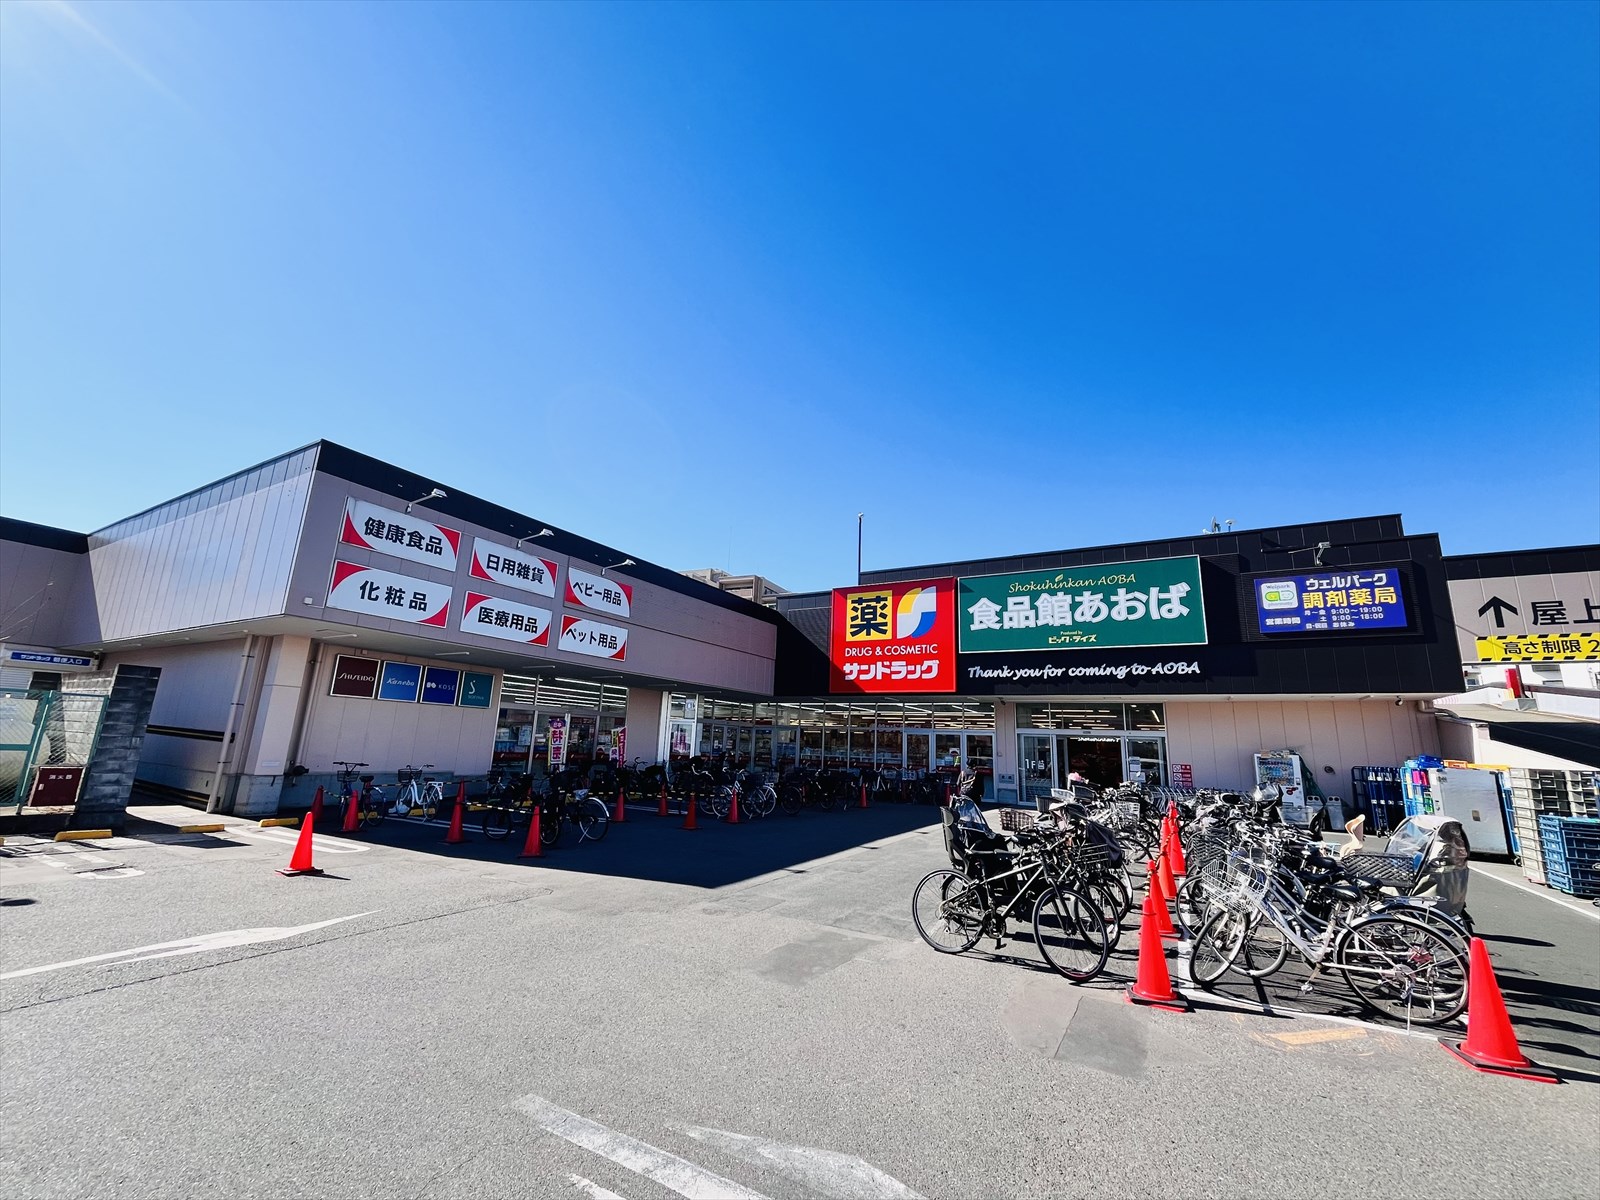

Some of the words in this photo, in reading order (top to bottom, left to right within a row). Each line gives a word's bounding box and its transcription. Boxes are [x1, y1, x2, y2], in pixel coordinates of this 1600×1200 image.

[364, 516, 443, 556] 健康食品
[486, 553, 545, 584] 日用雑貨
[1008, 574, 1096, 593] Shokuhinkan
[1098, 573, 1136, 584] AOBA
[1305, 573, 1387, 590] ウェルパーク
[359, 580, 428, 612] 化粧品
[572, 580, 622, 606] ベビー用品
[1302, 586, 1397, 609] 調剤薬局
[850, 595, 888, 637] 薬
[967, 581, 1191, 631] 食品館あおば
[1531, 598, 1600, 626] 屋上
[477, 606, 538, 634] 医療用品
[566, 628, 618, 650] ペット用品
[1502, 639, 1582, 655] 高さ制限
[845, 646, 872, 657] DRUG
[875, 646, 882, 656] &
[884, 644, 938, 655] COSMETIC
[337, 672, 375, 682] SHISEIDO
[843, 659, 939, 680] サンドラッグ
[968, 664, 1012, 678] Thank
[1012, 666, 1043, 680] you
[1043, 664, 1066, 679] for
[1068, 662, 1129, 679] coming
[1130, 662, 1148, 675] to
[1150, 661, 1200, 674] AOBA
[386, 677, 415, 687] Kanebo
